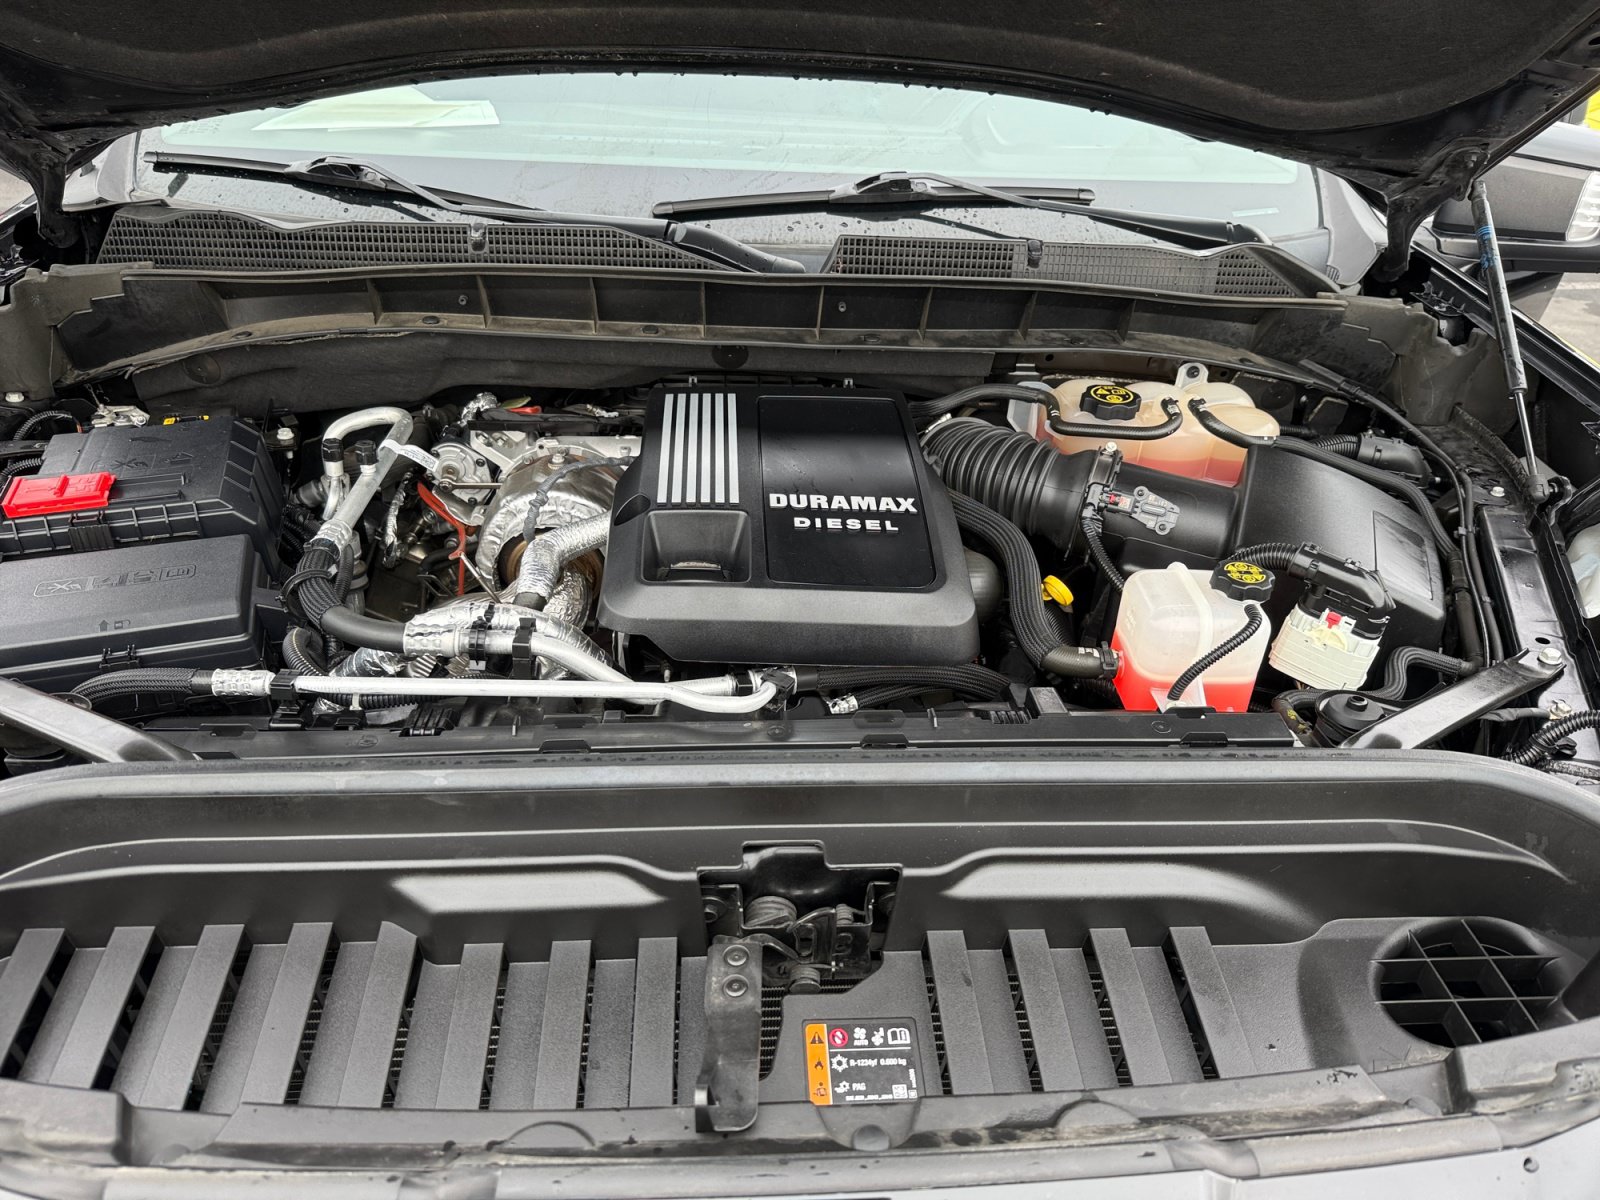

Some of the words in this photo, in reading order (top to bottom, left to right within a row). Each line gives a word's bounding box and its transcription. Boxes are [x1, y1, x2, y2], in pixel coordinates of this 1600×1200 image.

[769, 493, 918, 513] DURAMAX
[793, 517, 899, 531] DIESEL
[852, 1082, 867, 1091] PAG
